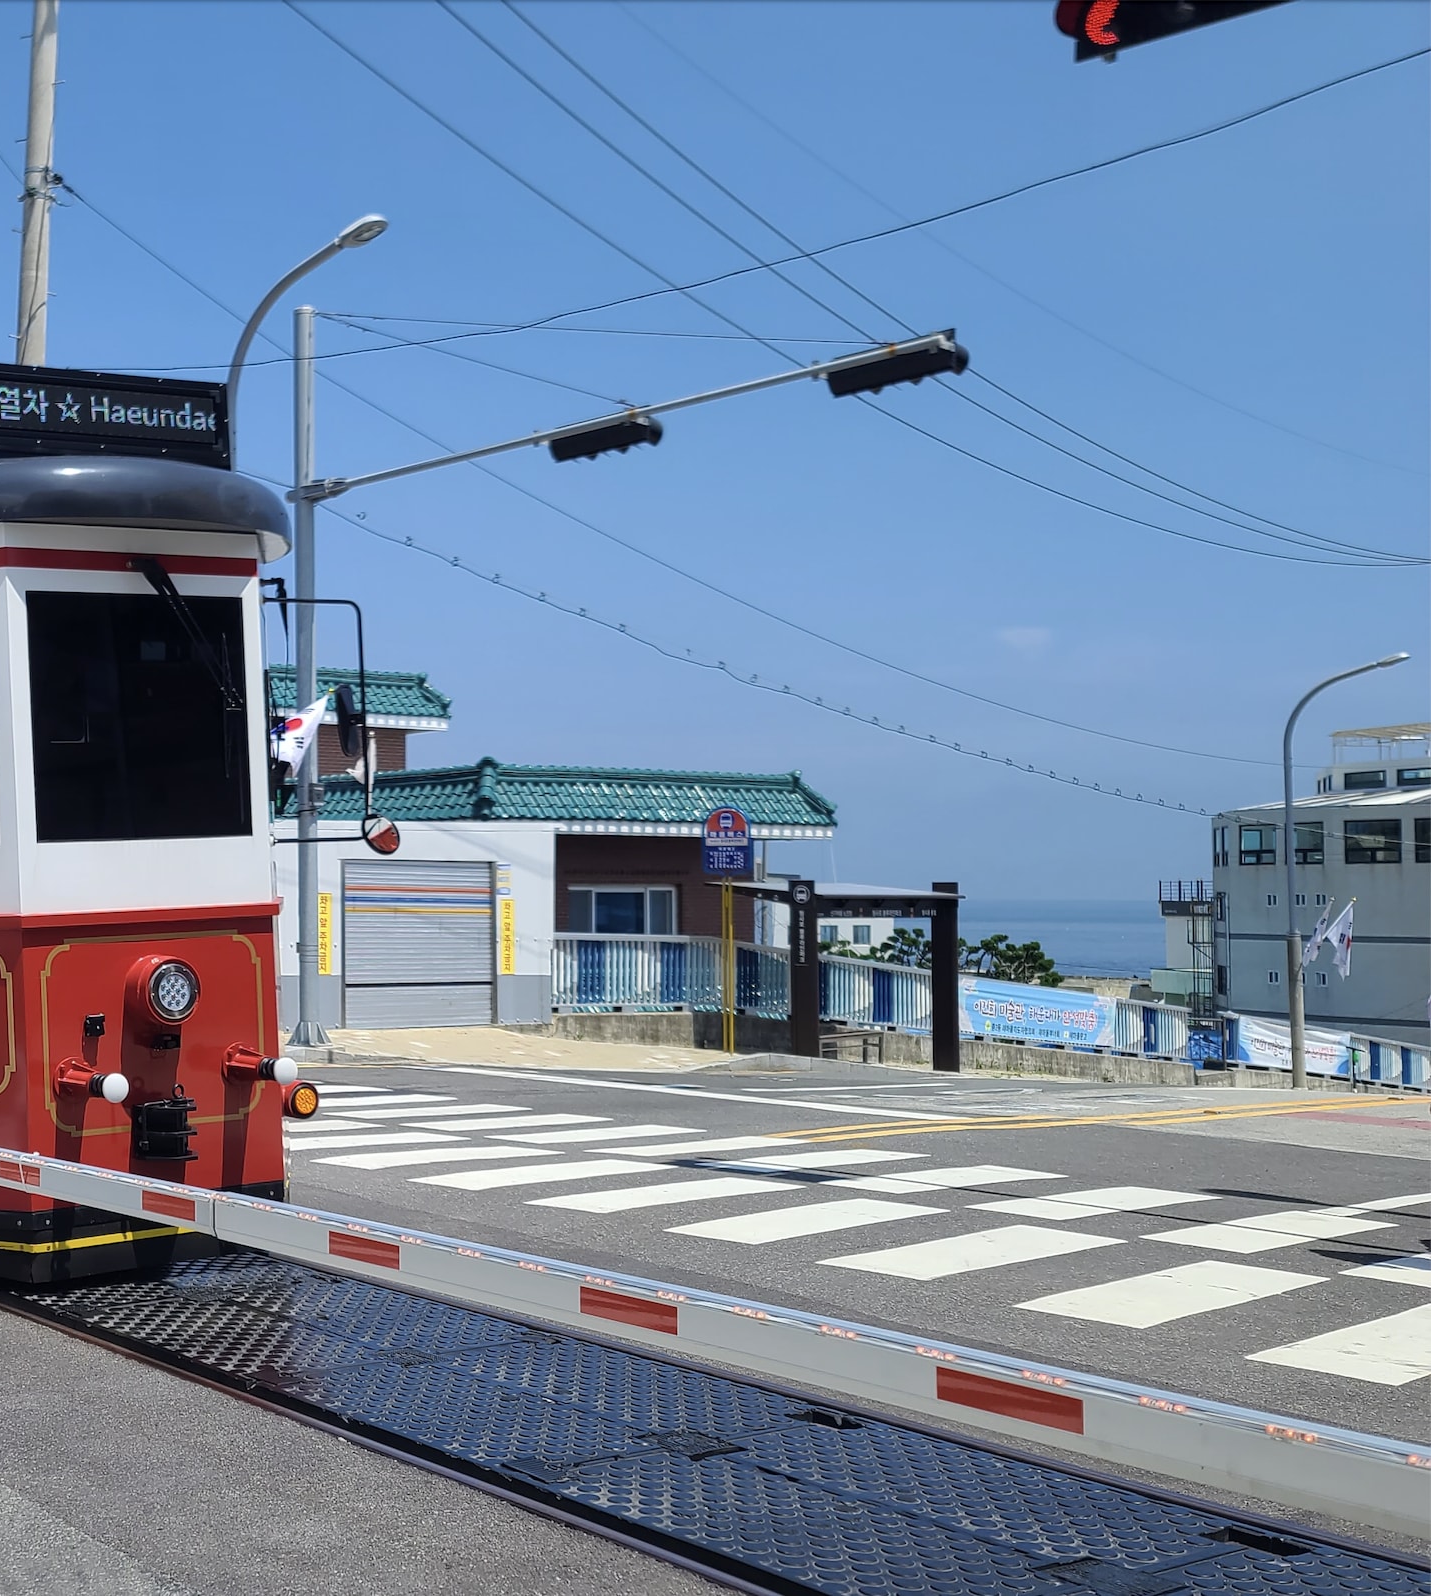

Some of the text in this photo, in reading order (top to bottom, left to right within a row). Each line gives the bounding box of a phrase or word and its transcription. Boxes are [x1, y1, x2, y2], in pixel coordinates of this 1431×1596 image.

[504, 902, 511, 919] 차고
[320, 896, 328, 972] 차고 앞 주차금지
[504, 922, 511, 931] 앞
[974, 999, 996, 1016] 이건희
[999, 1000, 1026, 1024] 미술관,
